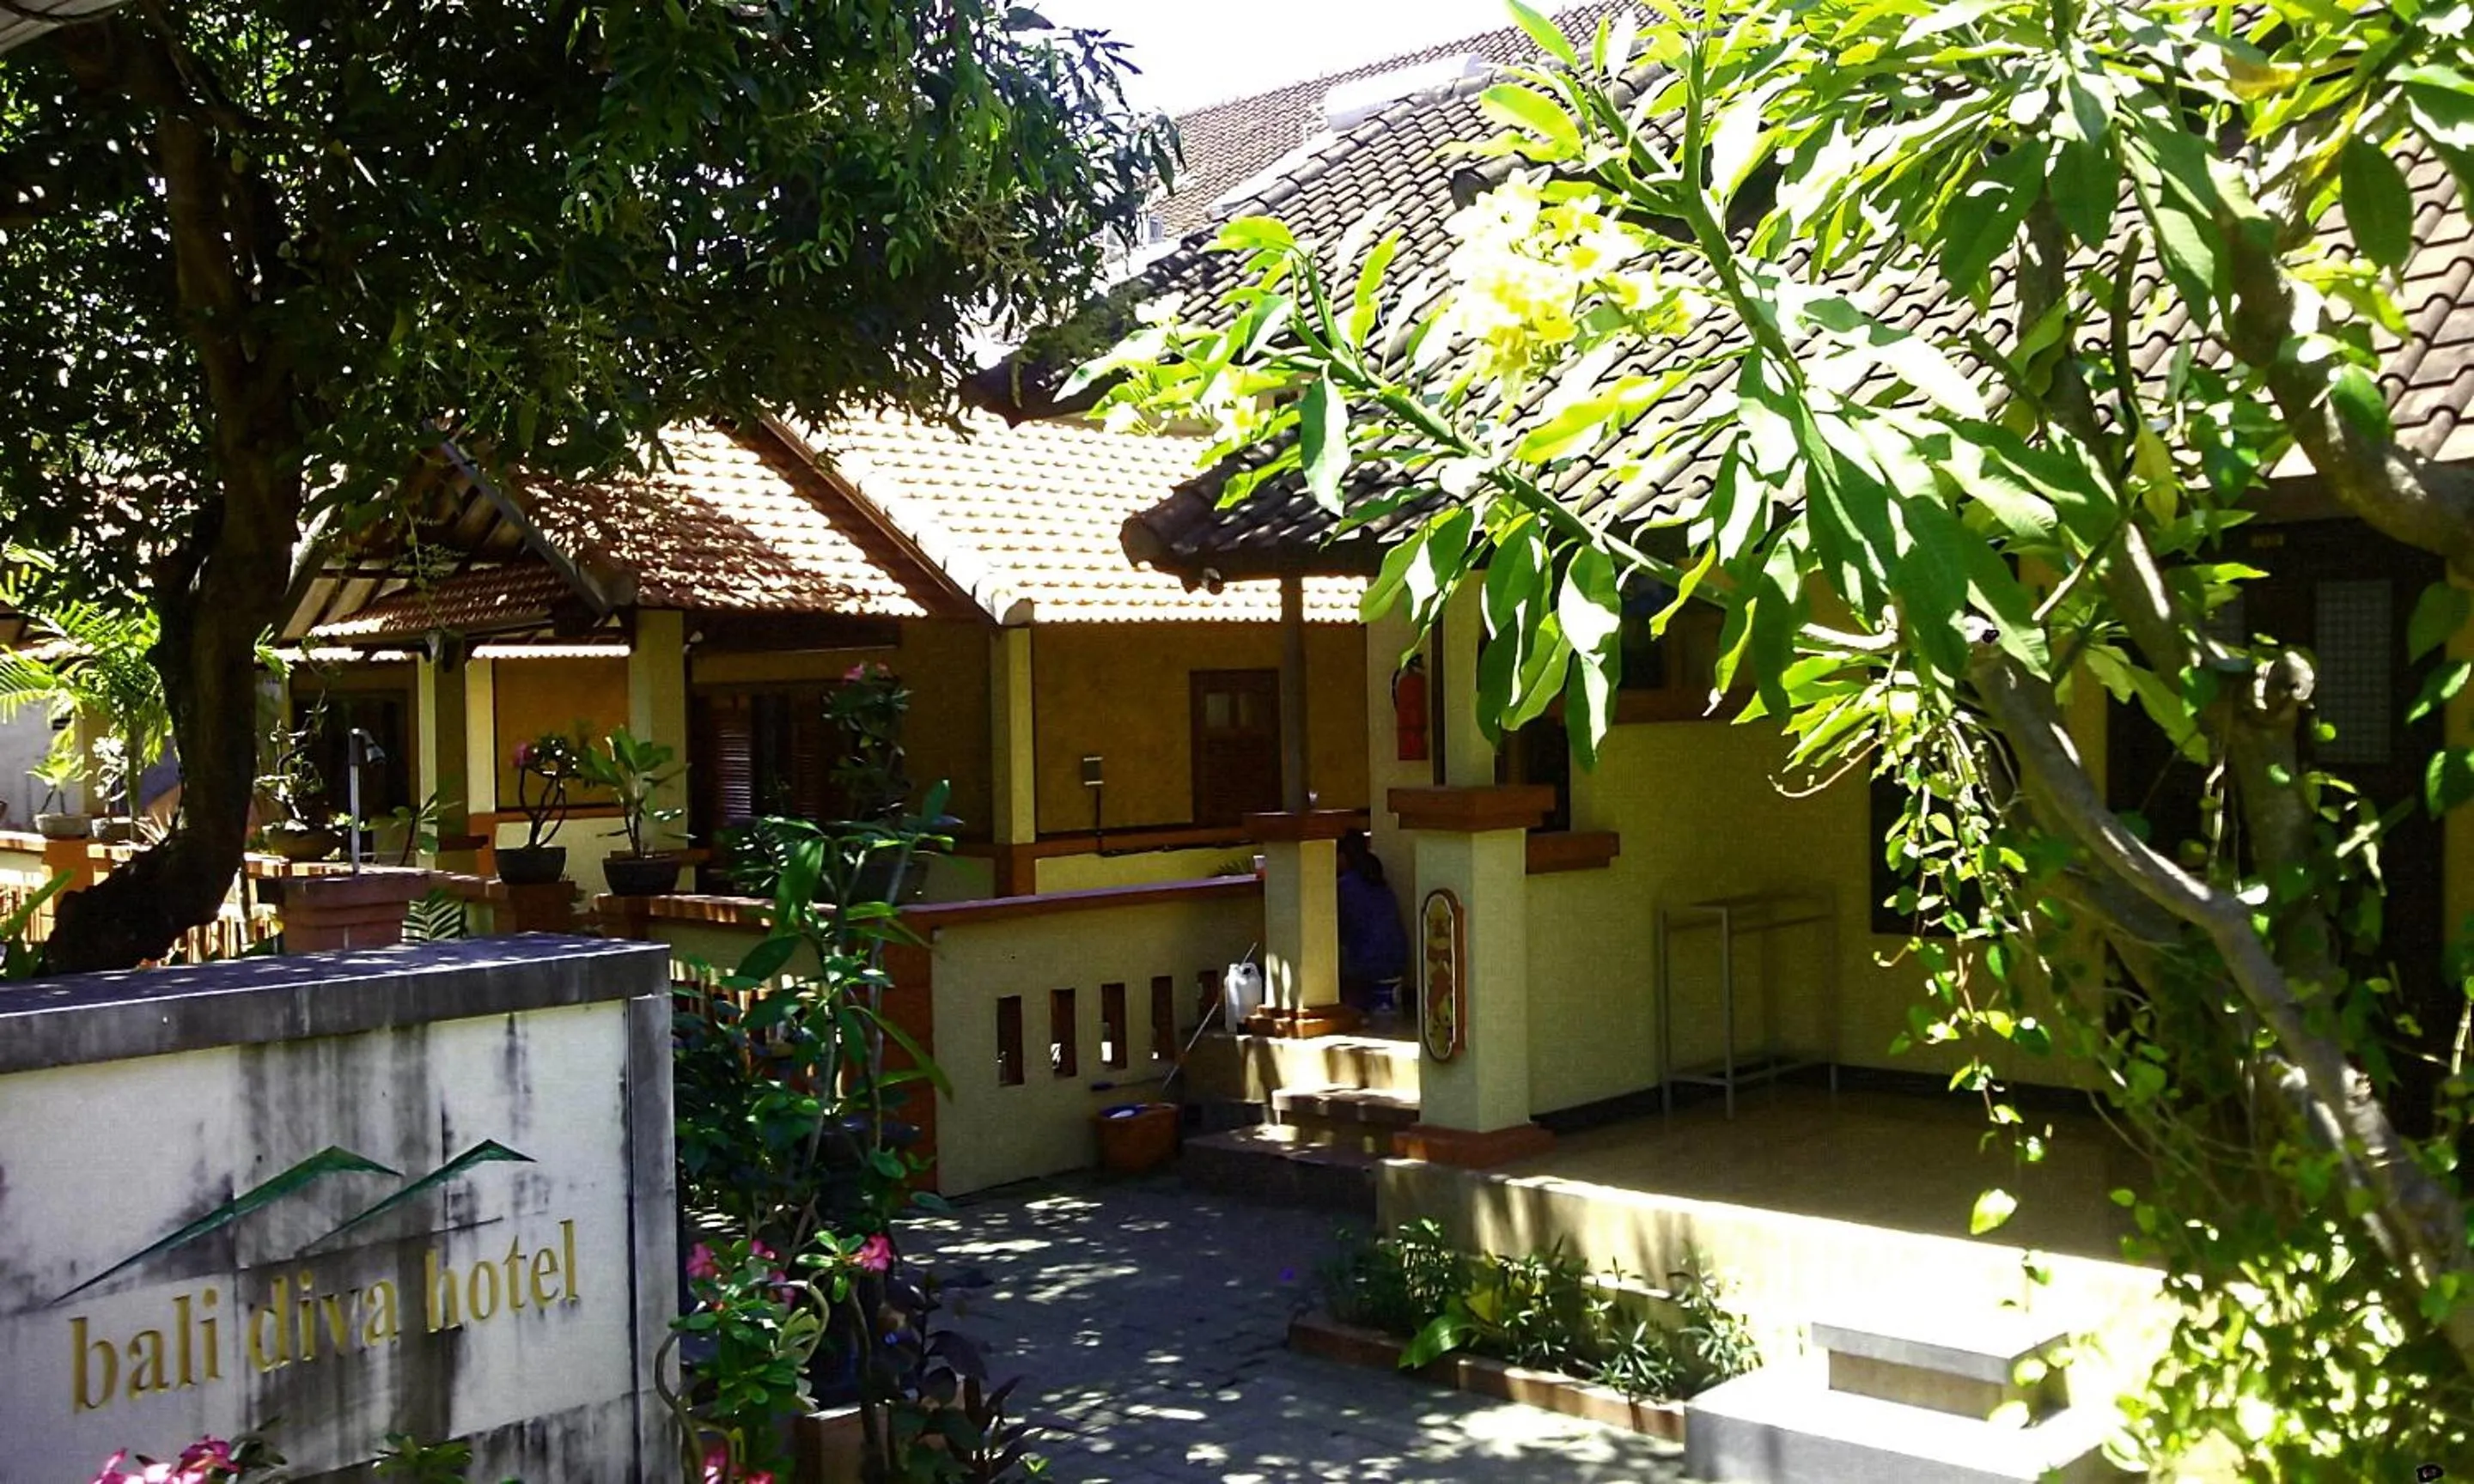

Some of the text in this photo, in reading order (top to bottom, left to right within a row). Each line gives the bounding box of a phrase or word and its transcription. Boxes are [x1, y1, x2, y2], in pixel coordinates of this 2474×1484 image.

[69, 1219, 579, 1414] bali diva hotel
